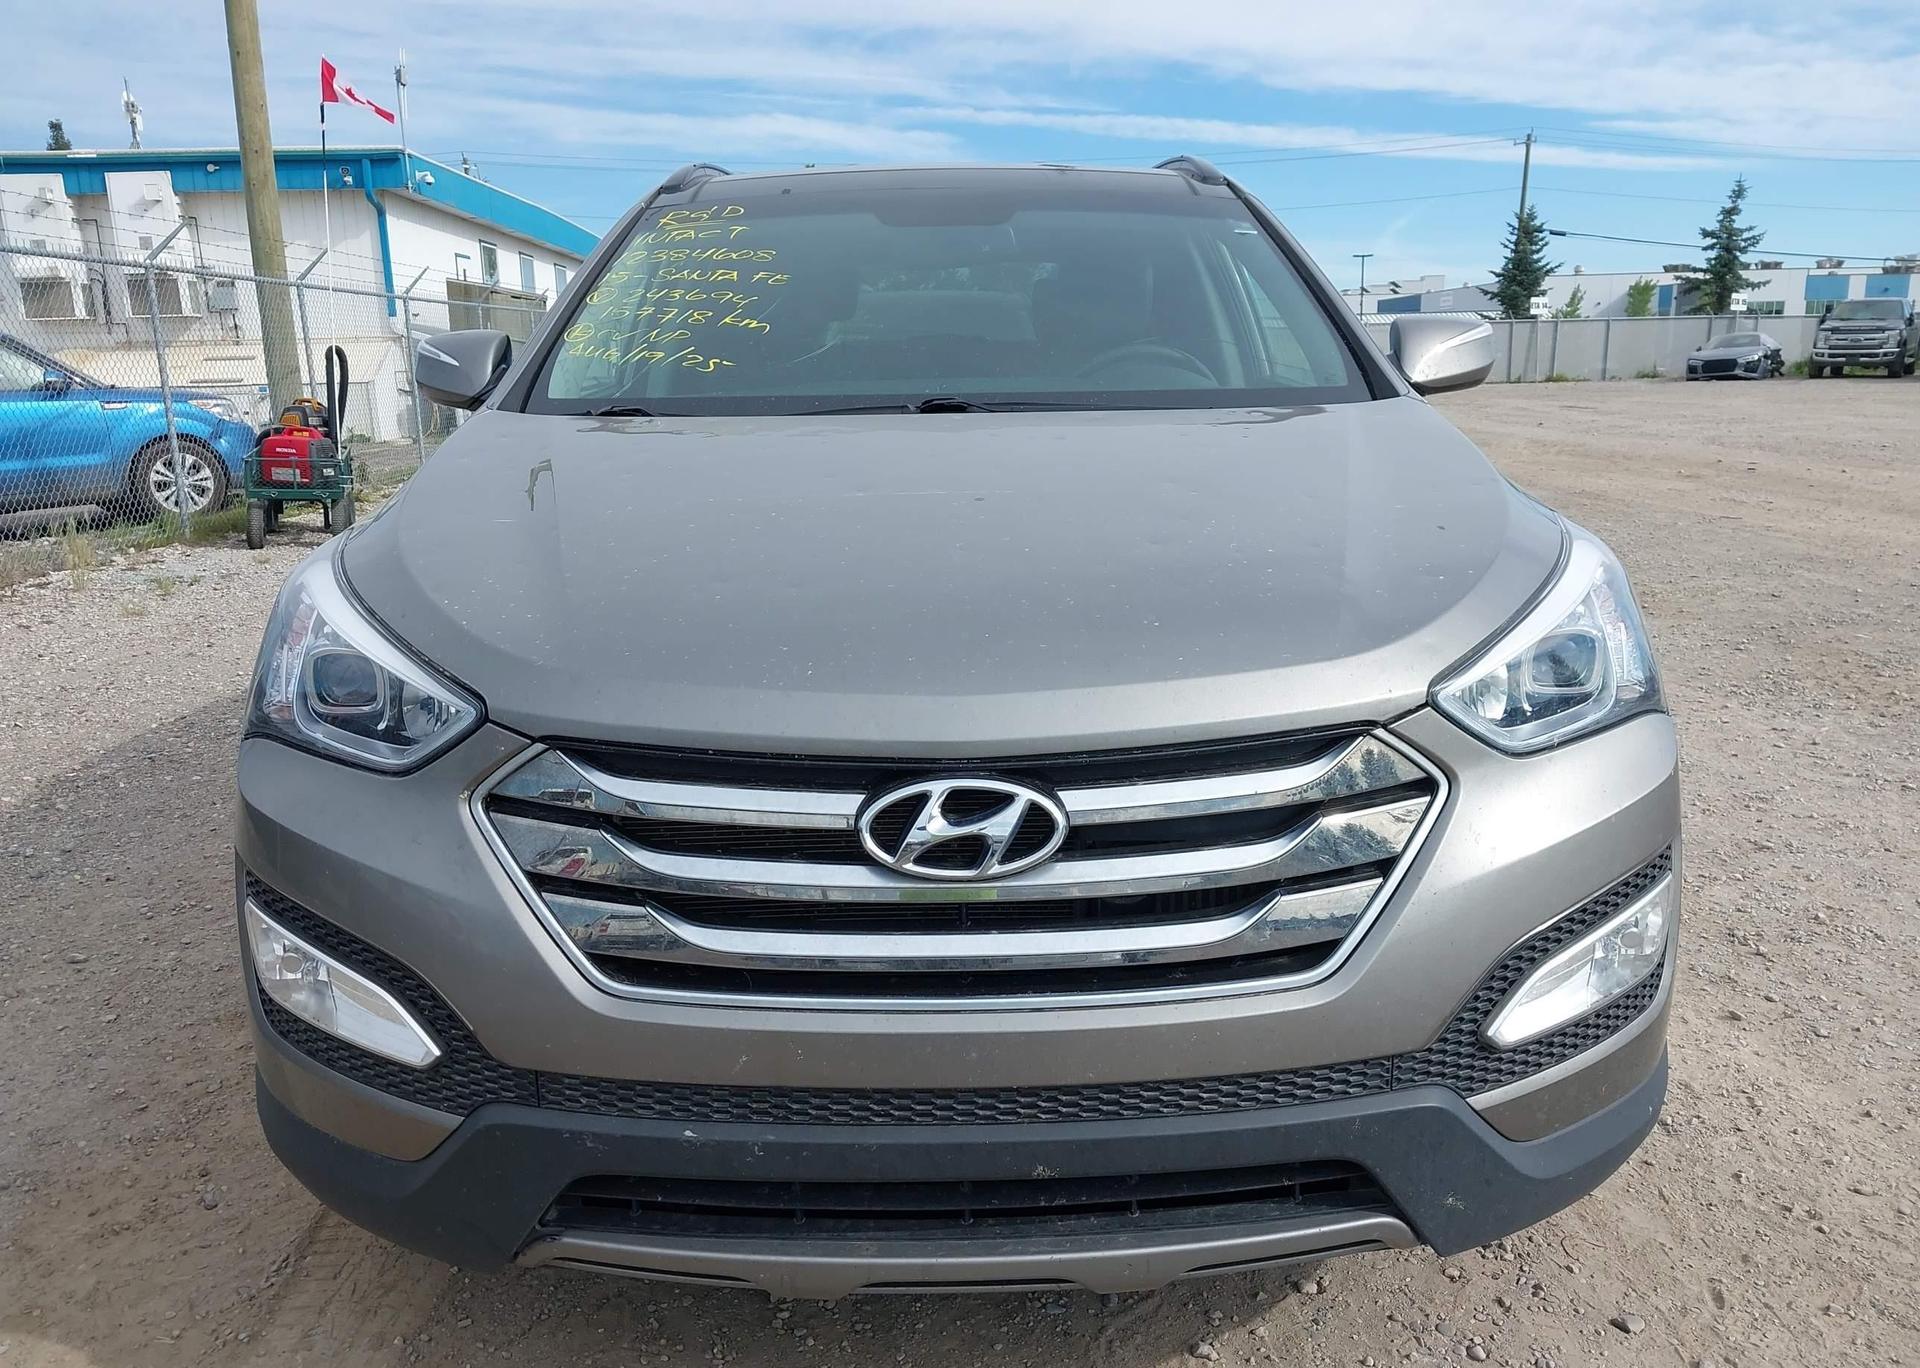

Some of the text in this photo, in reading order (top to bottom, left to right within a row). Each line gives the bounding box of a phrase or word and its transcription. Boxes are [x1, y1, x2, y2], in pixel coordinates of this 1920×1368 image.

[634, 226, 750, 246] INTACT
[651, 268, 738, 283] SANTA
[750, 272, 793, 286] FE
